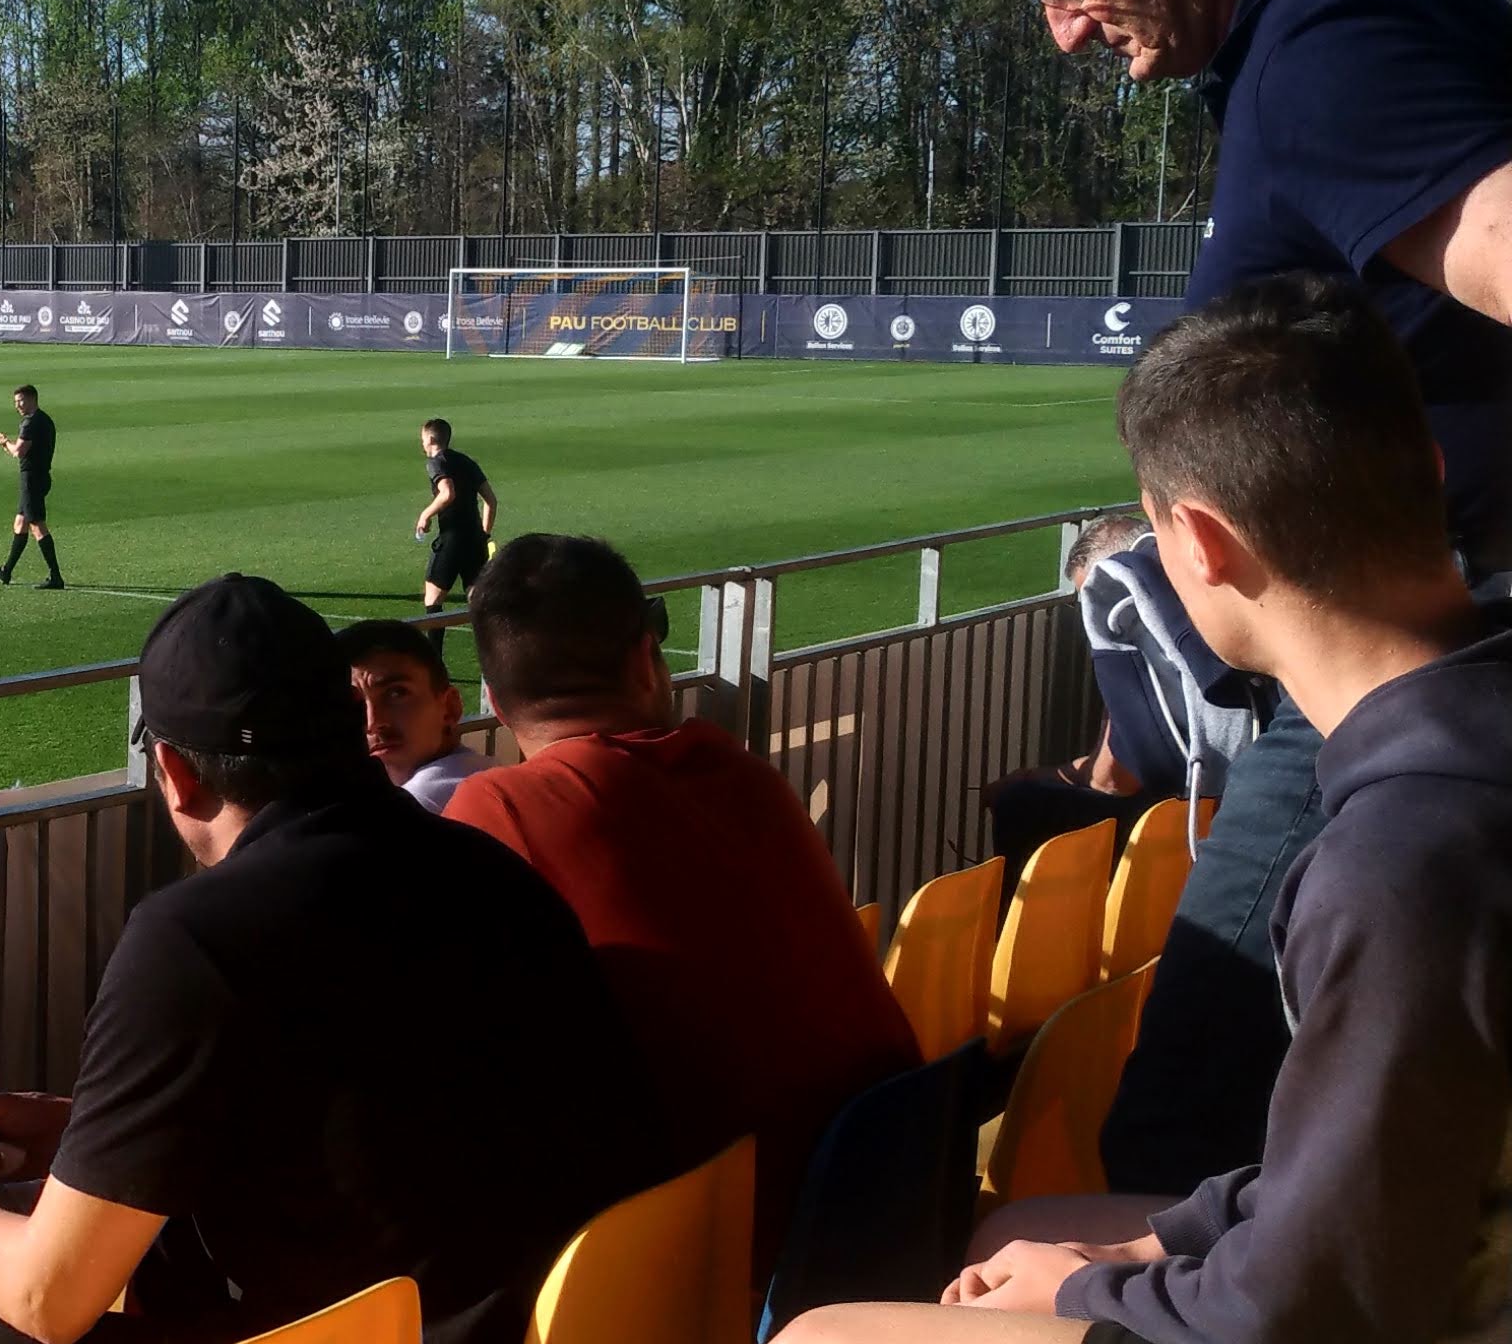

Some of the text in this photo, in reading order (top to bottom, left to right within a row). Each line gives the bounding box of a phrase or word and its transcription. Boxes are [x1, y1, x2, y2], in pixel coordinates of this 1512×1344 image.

[9, 315, 18, 323] DE
[19, 315, 32, 323] PAU
[60, 316, 85, 324] CASINO
[86, 316, 96, 324] DE
[550, 316, 737, 332] PAU FOOTBALL CLUB
[1092, 333, 1141, 345] Comfort
[1100, 346, 1134, 354] SUITES
